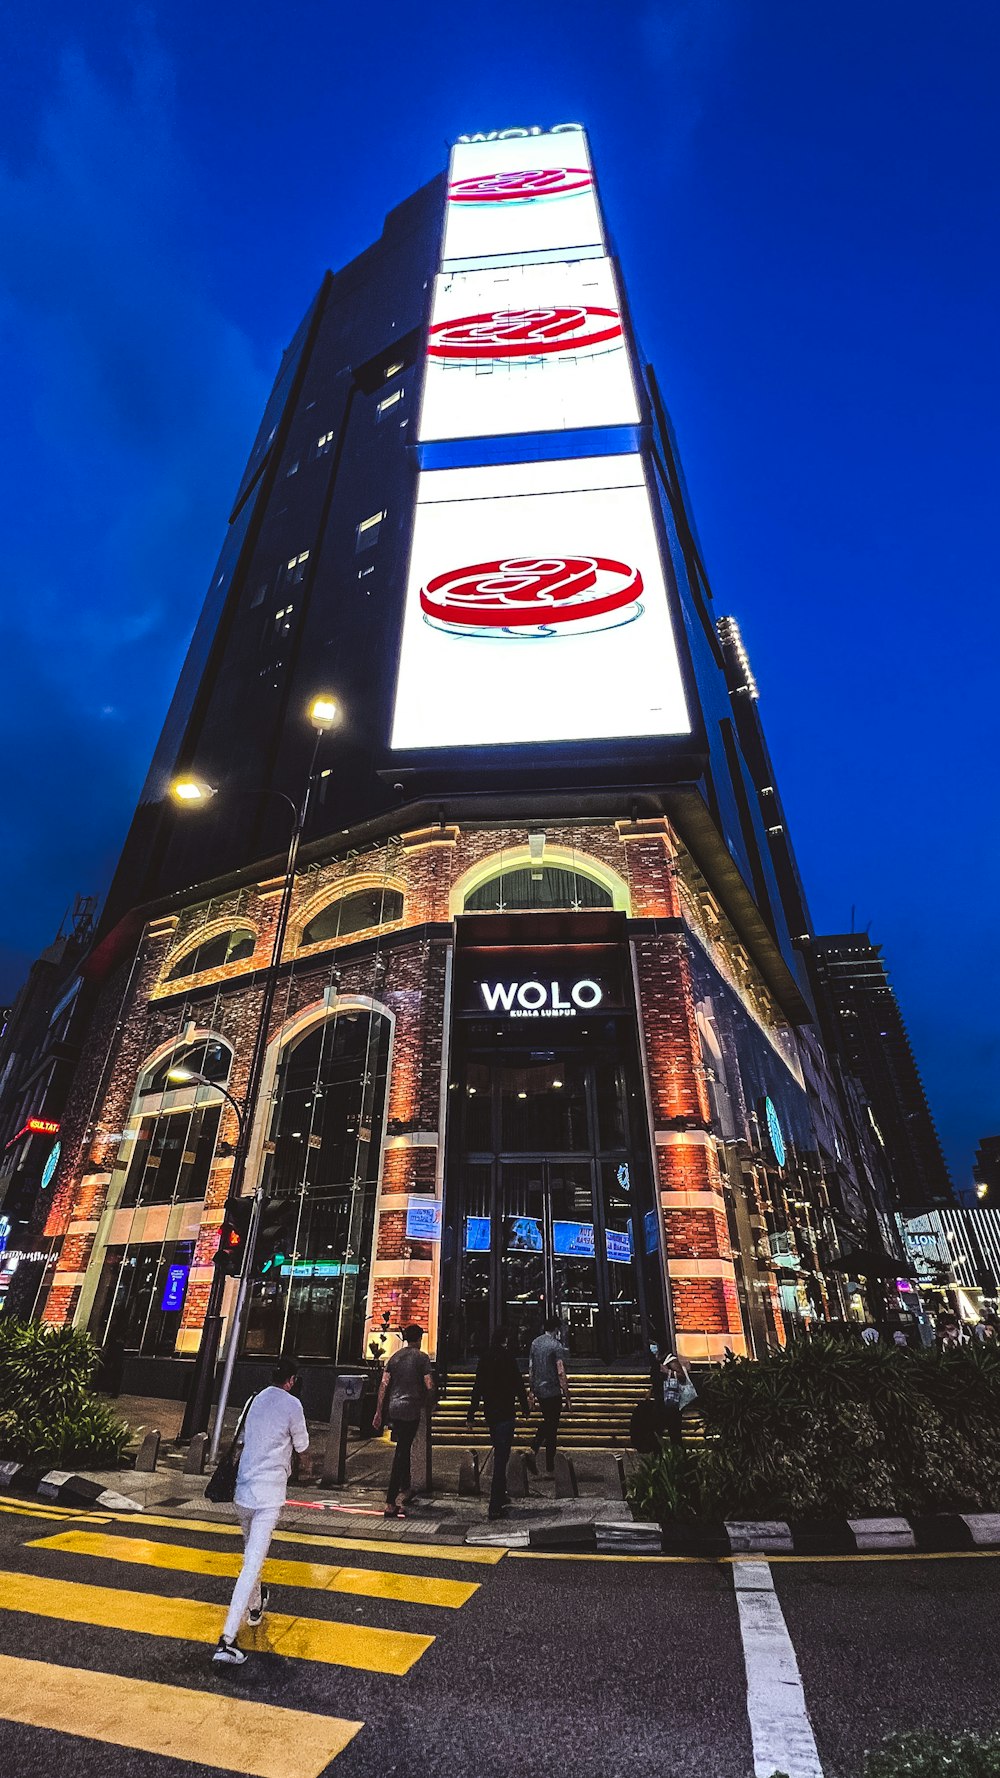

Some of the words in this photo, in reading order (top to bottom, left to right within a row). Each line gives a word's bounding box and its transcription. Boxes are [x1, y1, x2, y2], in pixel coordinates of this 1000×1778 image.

[480, 980, 602, 1010] WOLO
[510, 1009, 539, 1017] KUALA
[541, 1008, 577, 1017] LUMPUR
[907, 1235, 937, 1245] LION
